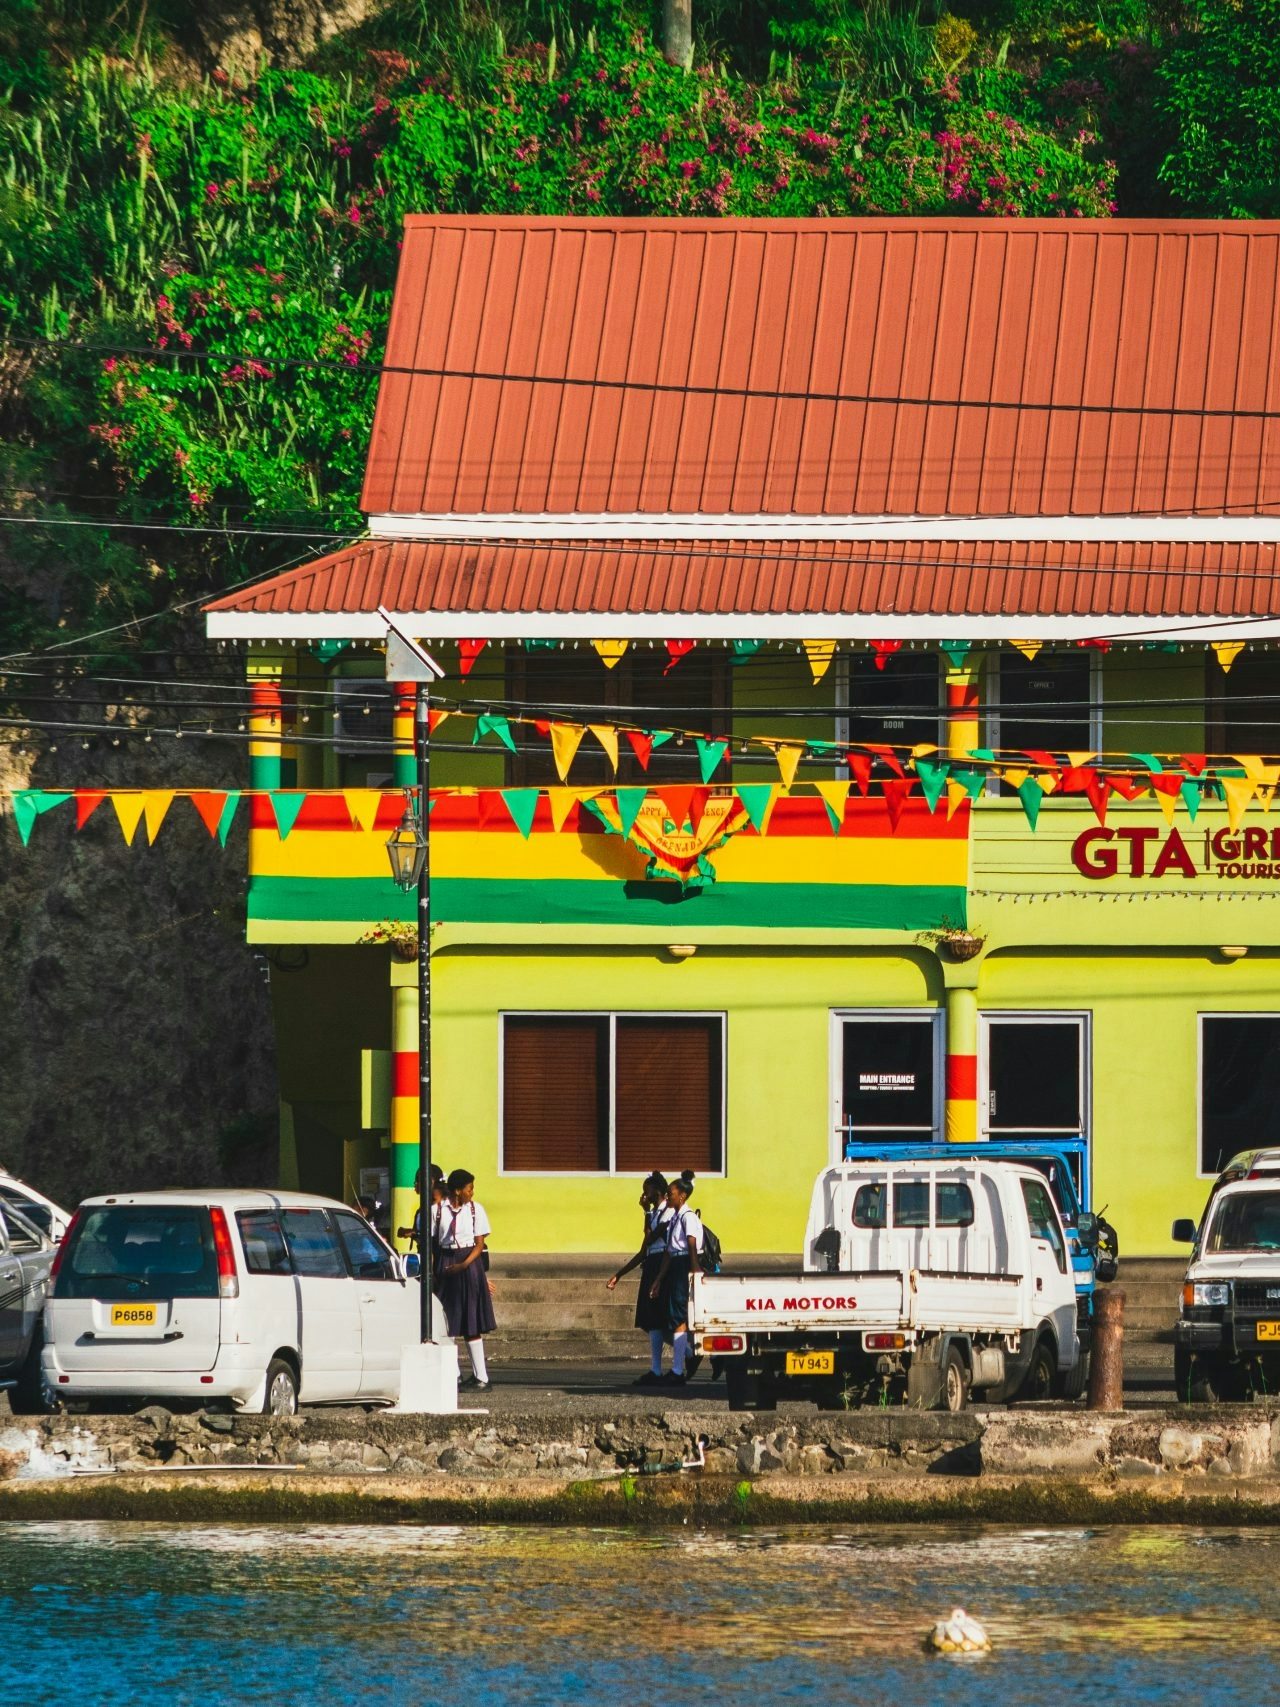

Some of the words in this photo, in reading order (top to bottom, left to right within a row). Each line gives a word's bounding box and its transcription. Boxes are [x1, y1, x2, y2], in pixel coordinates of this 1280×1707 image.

[883, 720, 904, 729] ROOM
[639, 807, 661, 816] APPY
[1071, 826, 1198, 880] GTA
[860, 1074, 878, 1084] MAIN
[879, 1074, 915, 1084] ENTRANCE
[745, 1298, 776, 1310] KIA
[783, 1297, 858, 1310] MOTORS
[115, 1310, 153, 1321] P6858
[792, 1358, 805, 1370] TV
[807, 1358, 829, 1370] 943
